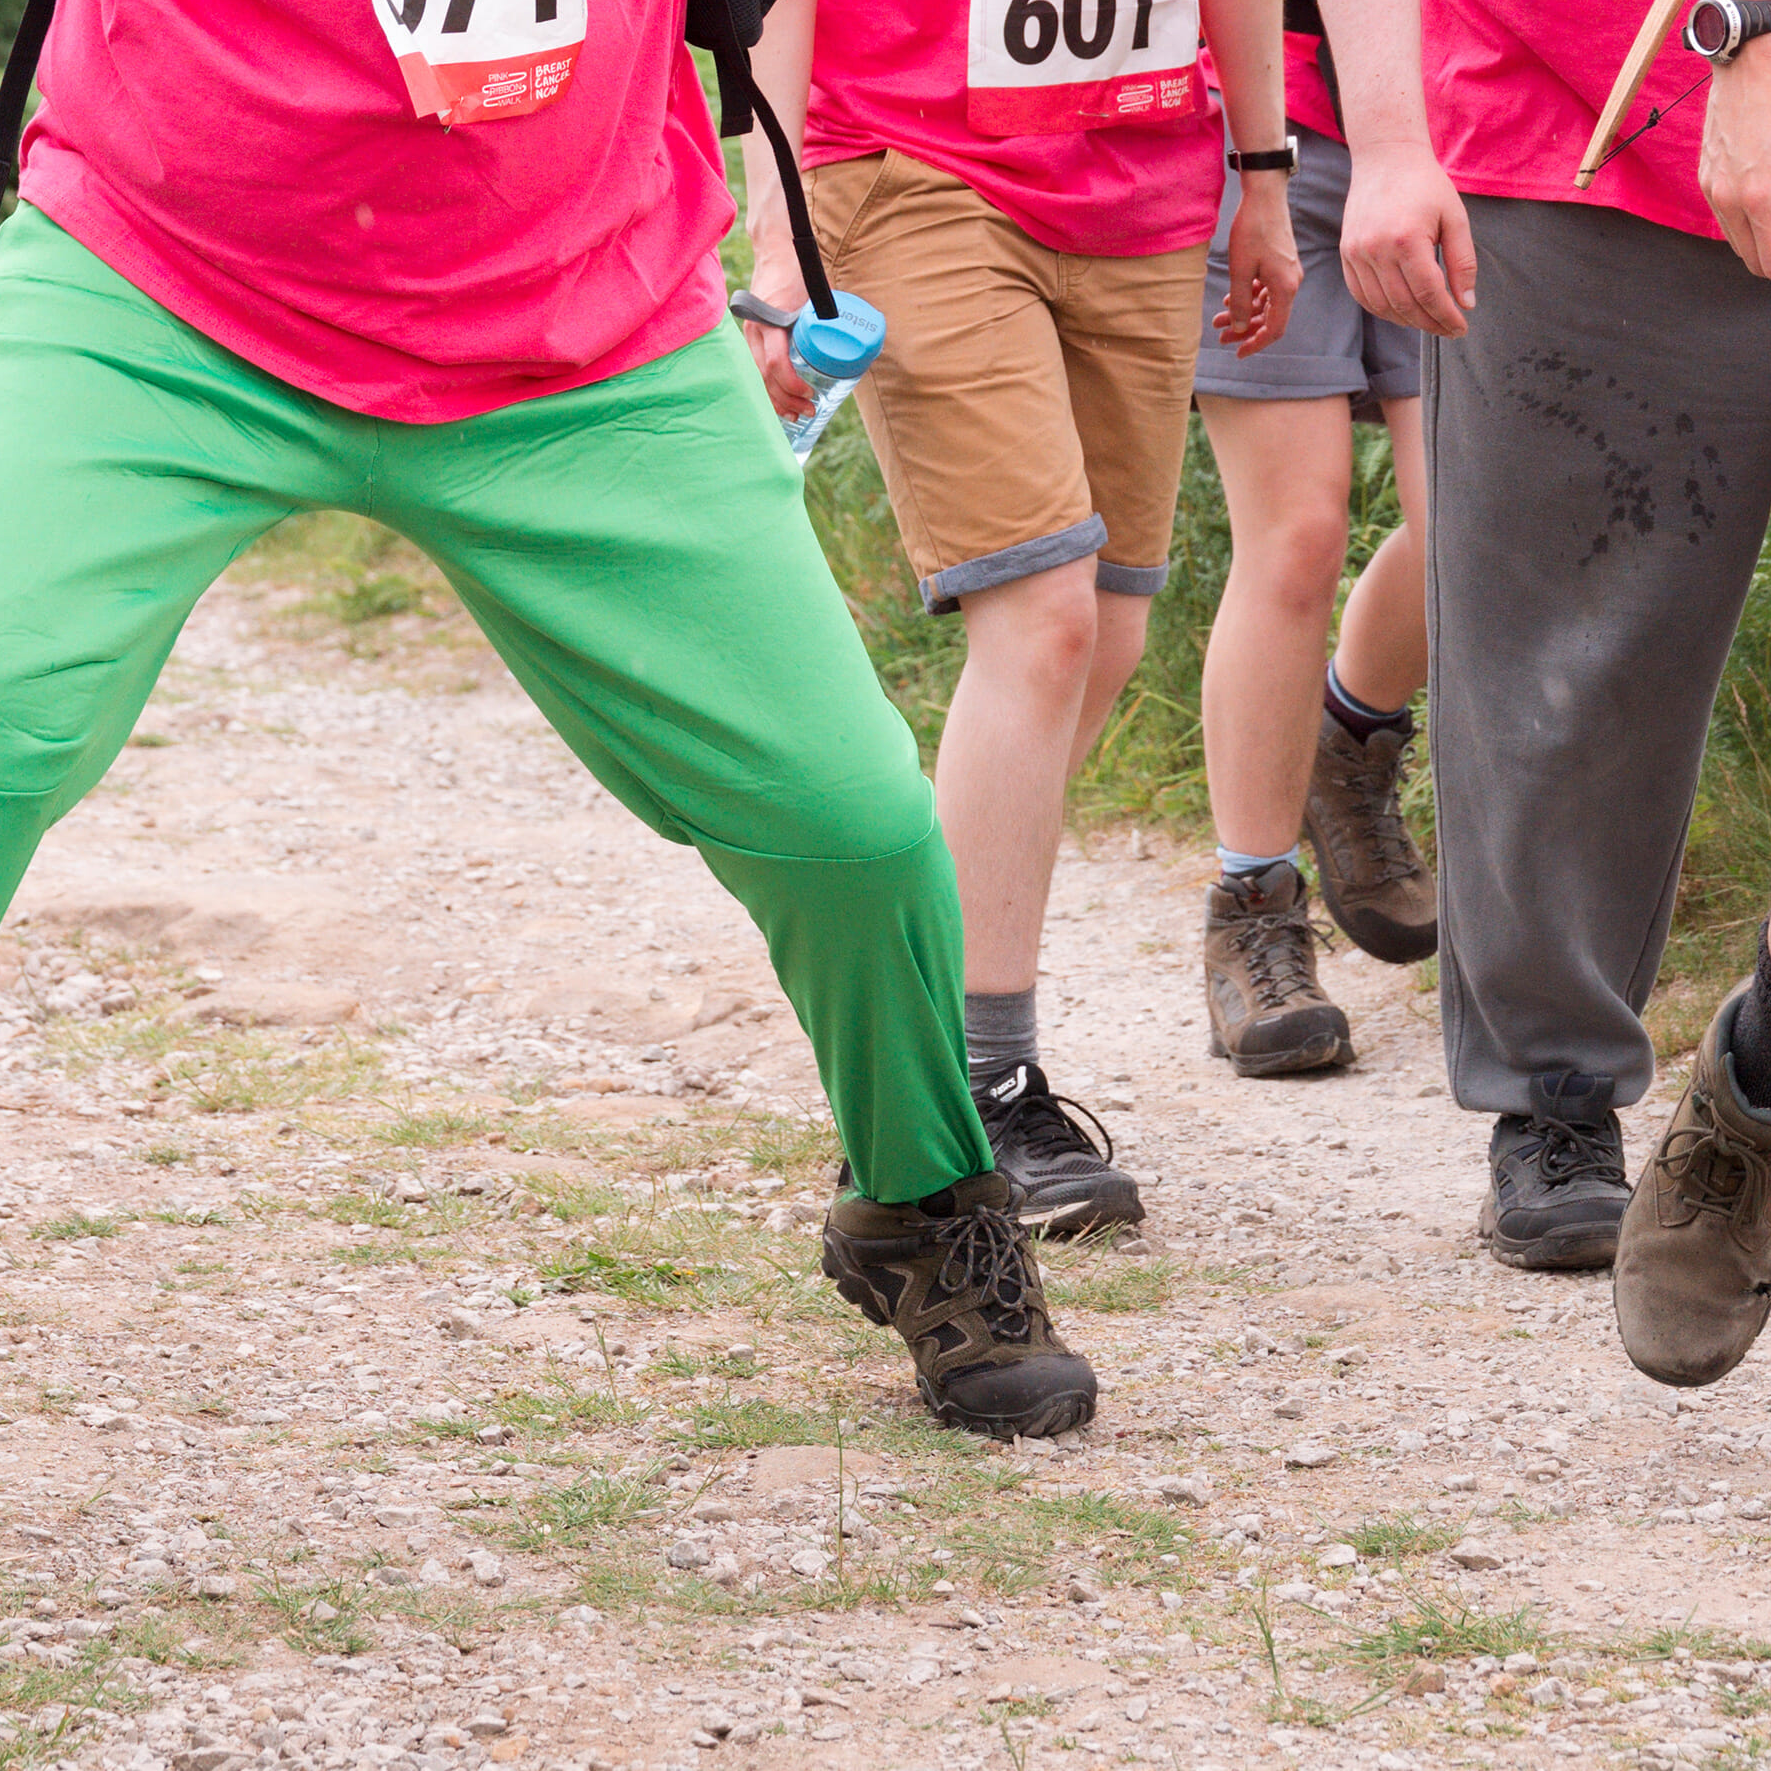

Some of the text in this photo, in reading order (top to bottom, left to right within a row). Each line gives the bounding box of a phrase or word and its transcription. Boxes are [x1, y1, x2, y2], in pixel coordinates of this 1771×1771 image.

[535, 57, 572, 78] BREAST
[488, 71, 509, 83] PINK
[534, 69, 571, 88] CANCER
[489, 83, 523, 96] RIBBON
[535, 85, 559, 100] NOW
[498, 95, 522, 107] WALK
